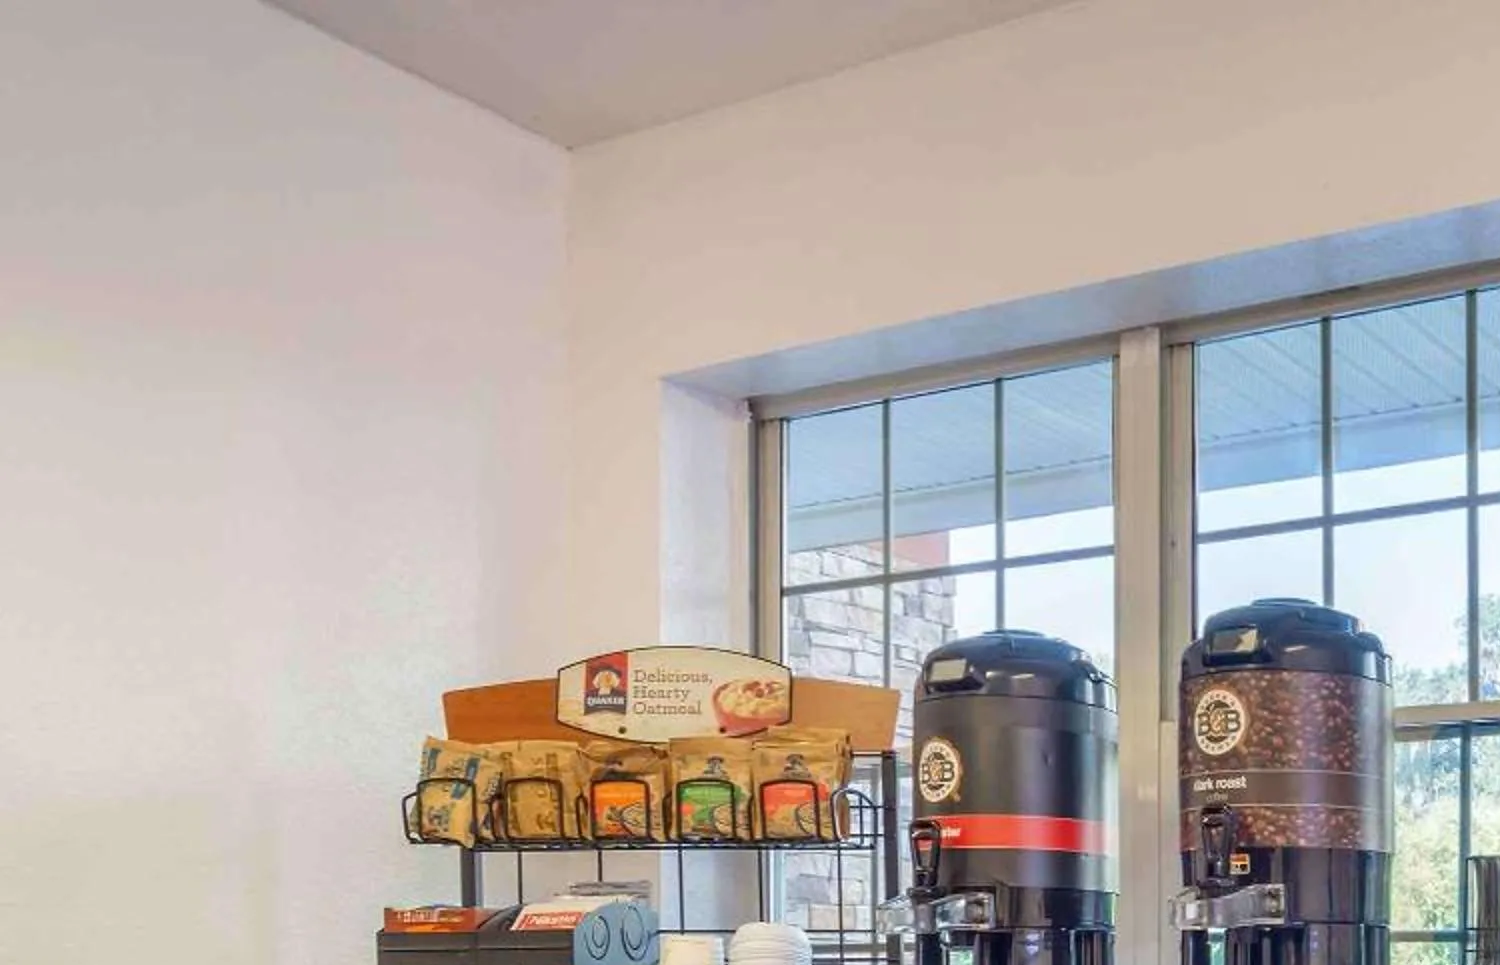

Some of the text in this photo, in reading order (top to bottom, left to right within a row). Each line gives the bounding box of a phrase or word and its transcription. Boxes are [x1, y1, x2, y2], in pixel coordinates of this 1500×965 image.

[633, 667, 713, 685] Delicious,
[633, 685, 691, 702] Hearty
[633, 700, 702, 715] Oatmeal
[1216, 775, 1248, 790] roast
